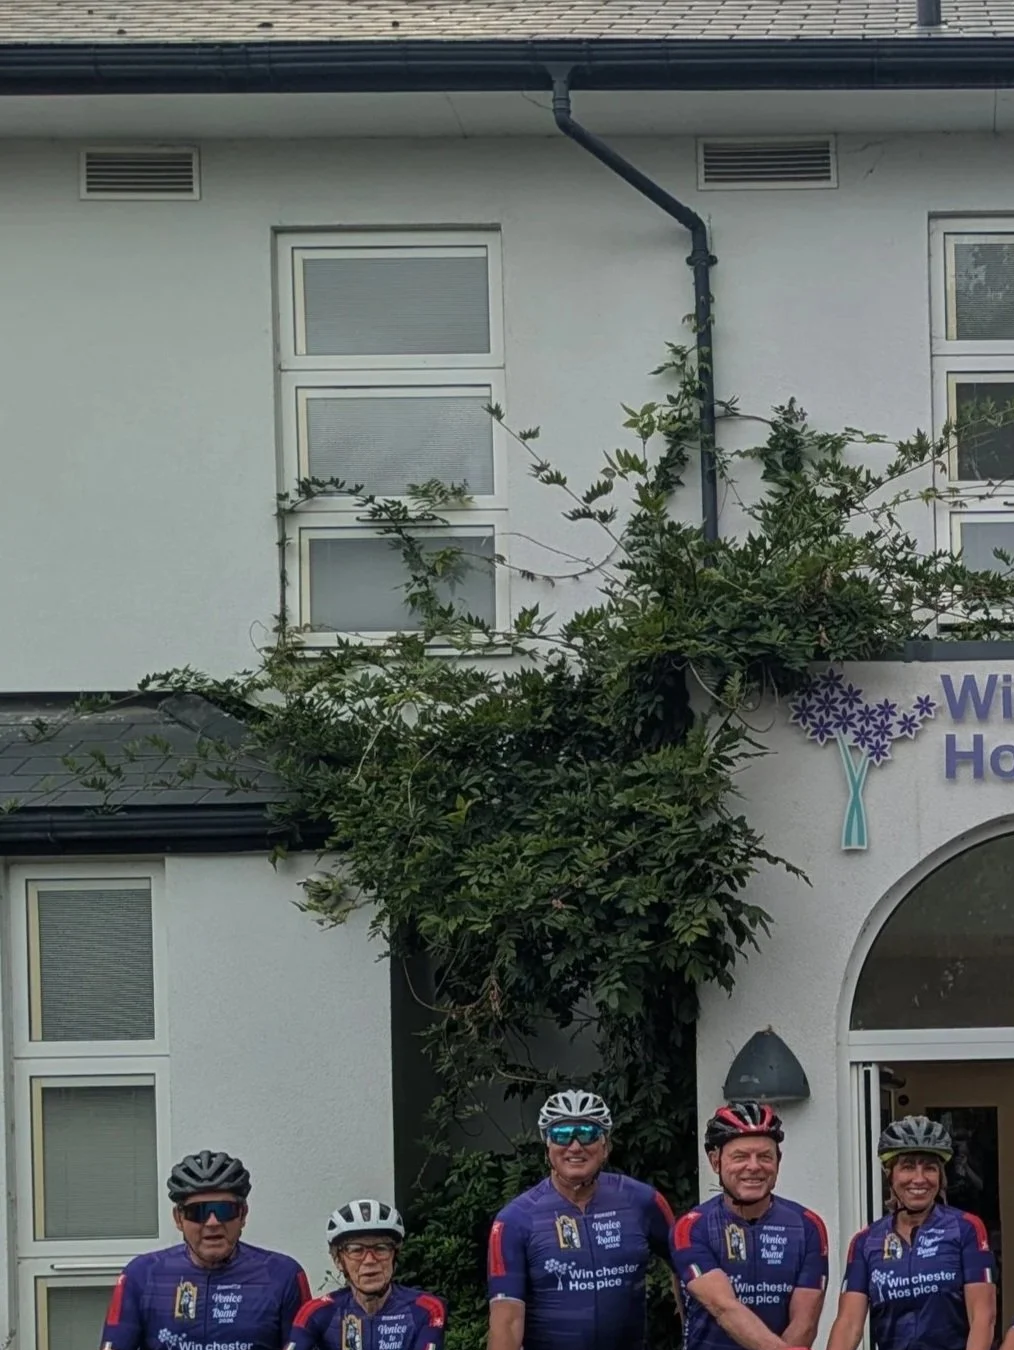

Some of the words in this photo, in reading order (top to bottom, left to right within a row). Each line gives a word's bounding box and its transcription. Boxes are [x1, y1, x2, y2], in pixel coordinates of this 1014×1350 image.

[569, 1277, 622, 1291] Hospice
[734, 1281, 792, 1293] Wincheste
[888, 1284, 938, 1300] Hospice
